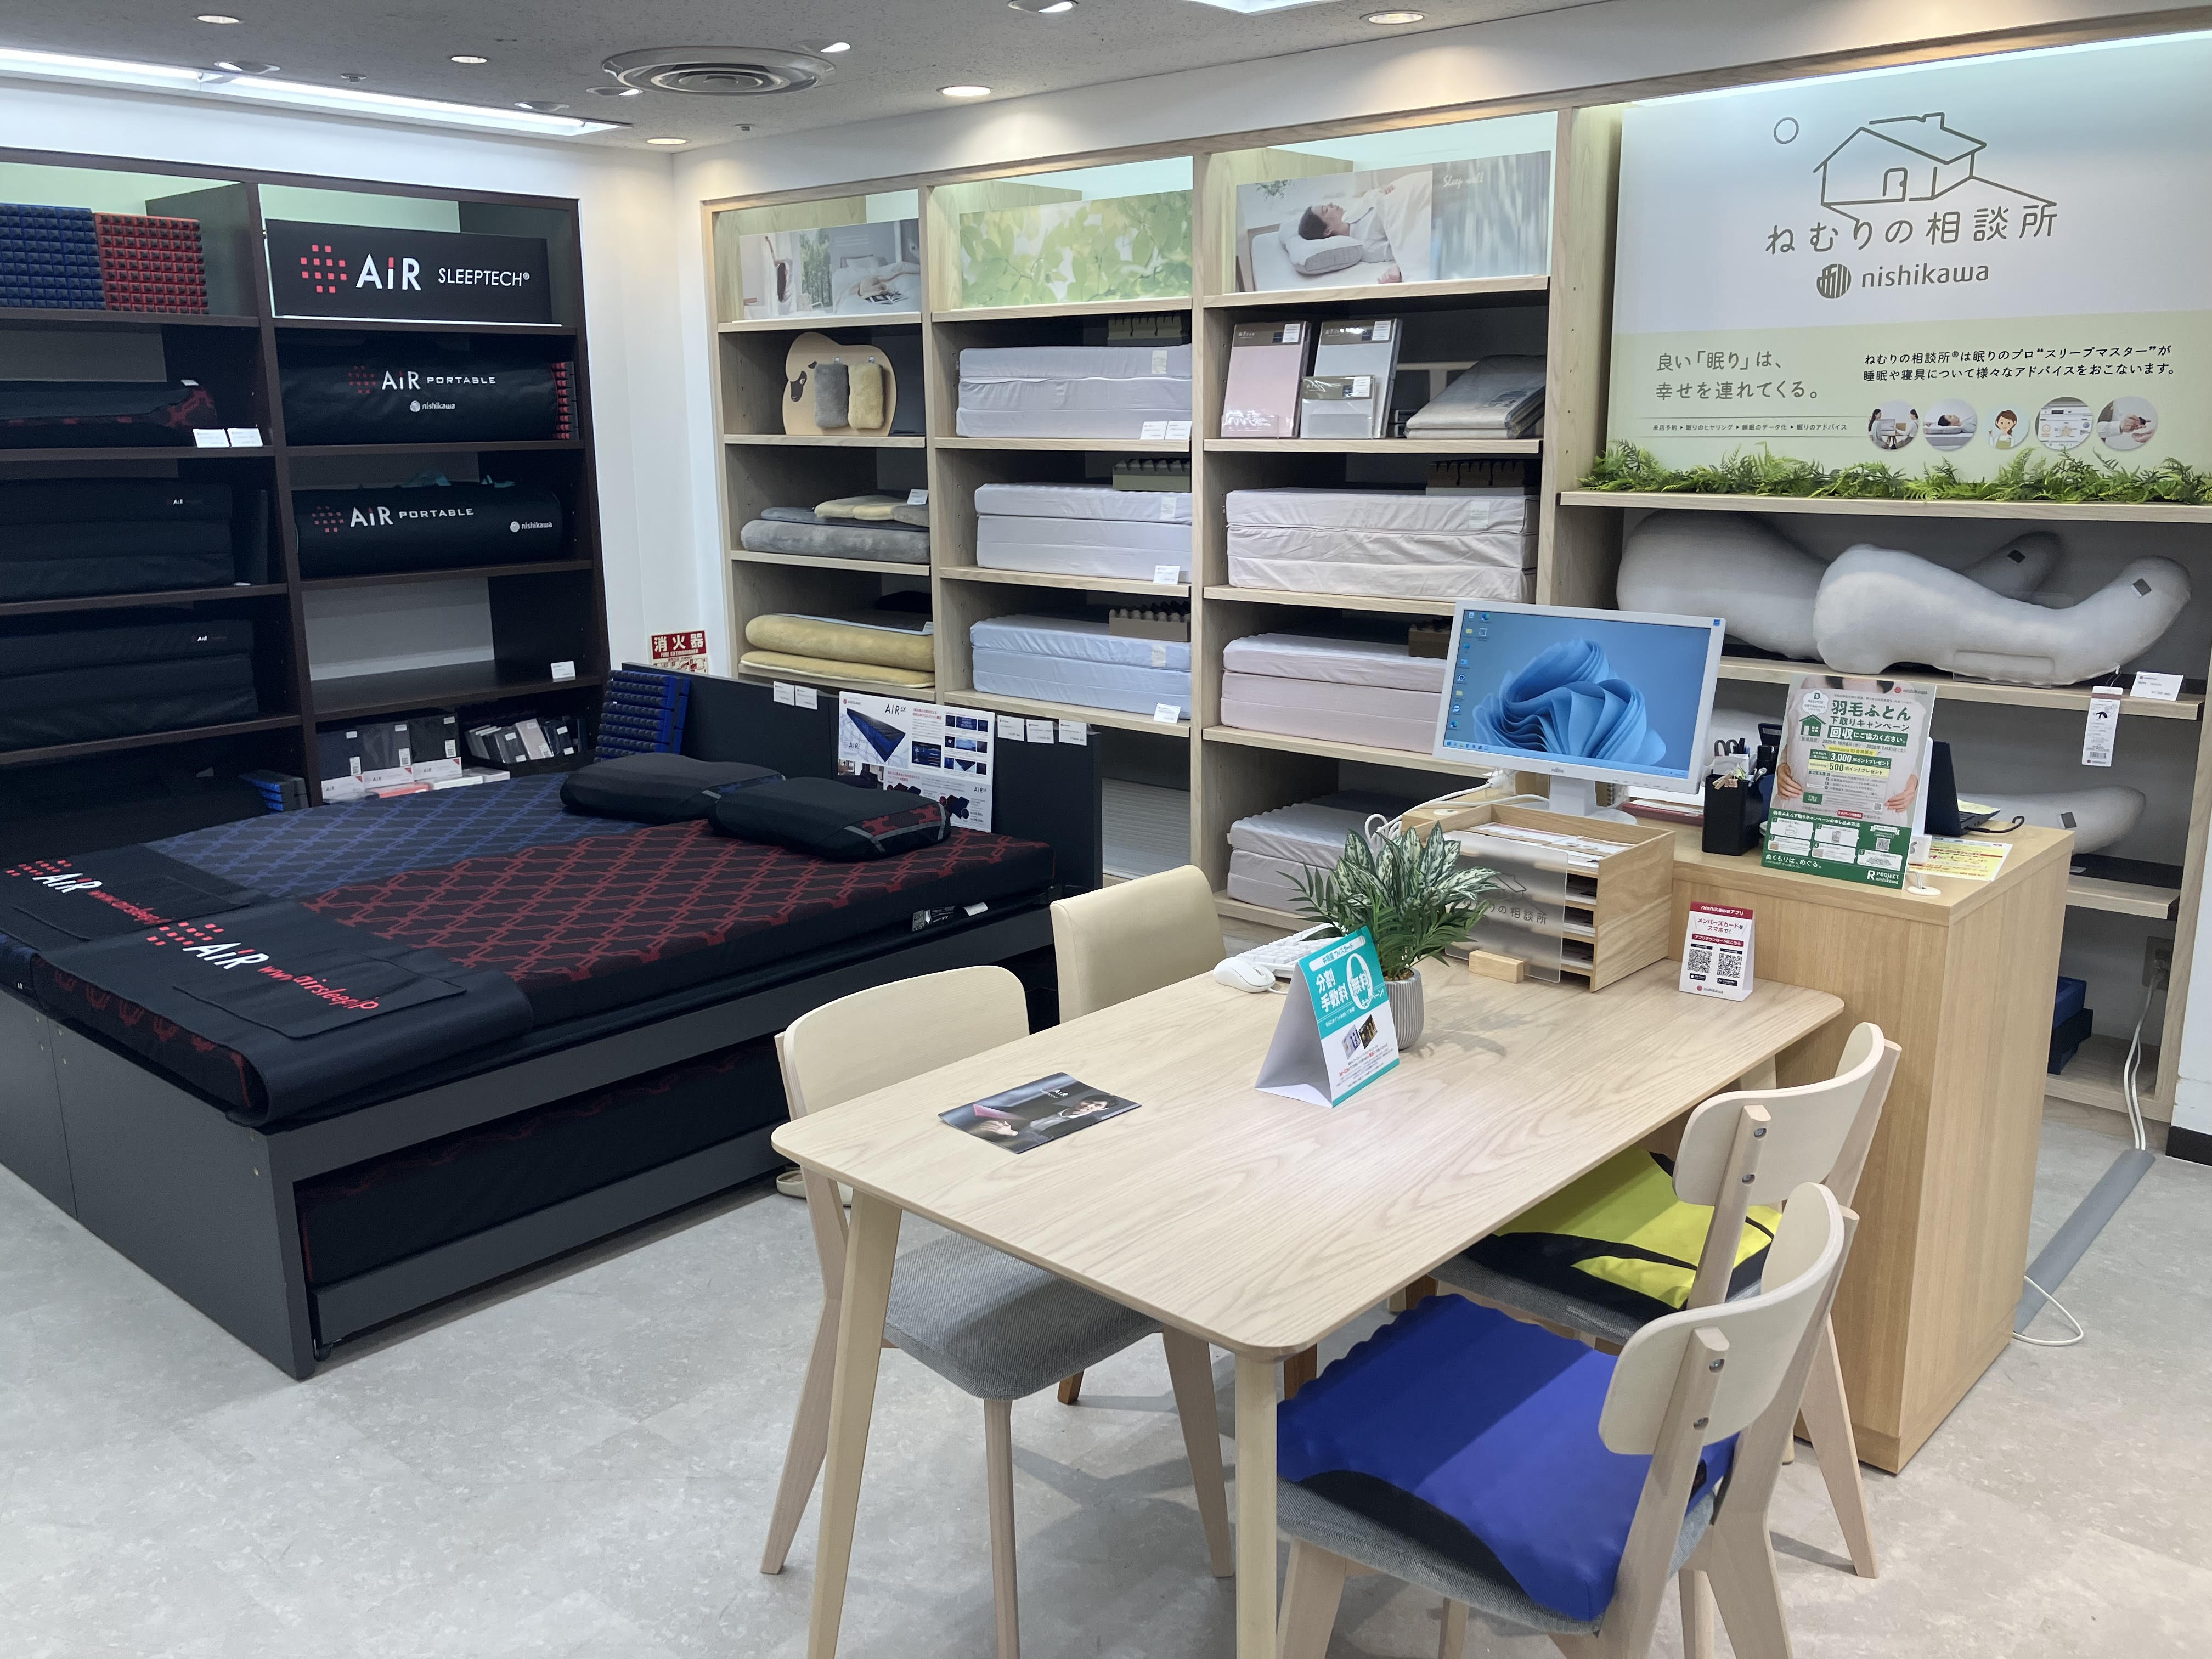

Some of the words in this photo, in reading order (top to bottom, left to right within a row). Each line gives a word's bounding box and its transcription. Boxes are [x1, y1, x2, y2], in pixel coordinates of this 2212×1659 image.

[1765, 206, 2057, 255] ねむりの相談所
[1861, 263, 1989, 288] nishikawa
[1656, 351, 1781, 371] 良い「眠り」は、
[427, 376, 496, 385] PORTABLE
[1863, 362, 2174, 381] 睡眠や寝具について様々なアドバイスをおこないます。
[1656, 380, 1817, 400] 幸せを連れてくる。
[422, 401, 456, 411] nishikawa
[399, 508, 474, 518] PORTABLE
[521, 521, 552, 529] nishikawa
[654, 633, 703, 652] 消火器
[1831, 699, 1911, 721] 羽毛ふとん
[1830, 716, 1909, 731] 下取りキャンペーン
[1830, 726, 1906, 744] 回収にご協力ください。
[1830, 753, 1852, 762] 3,000
[1830, 763, 1844, 771] 500
[1765, 854, 1822, 868] ぬくもりは、めぐる。
[1867, 870, 1875, 881] R
[1697, 918, 1743, 930] メンバーズカードを
[1316, 968, 1336, 994] 分割
[1350, 970, 1370, 996] 無料
[1321, 983, 1348, 1013] 手数料
